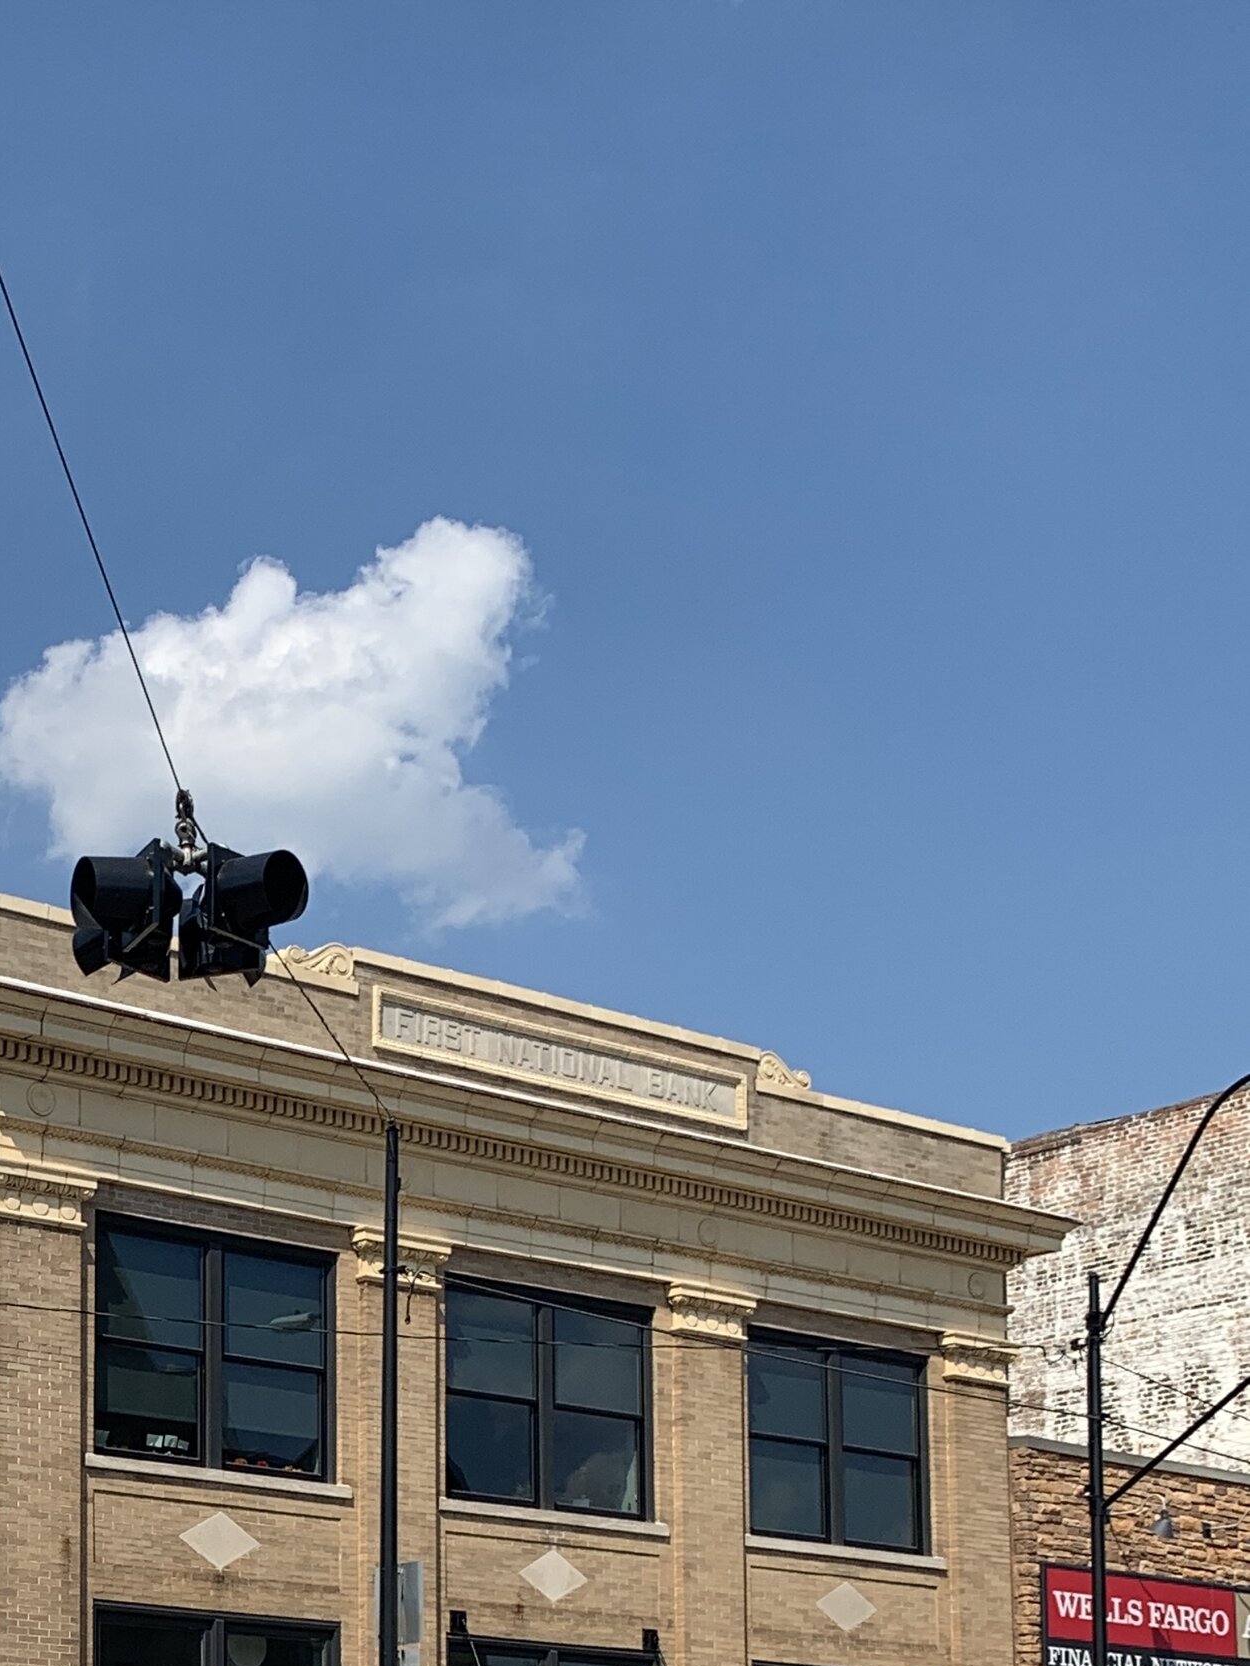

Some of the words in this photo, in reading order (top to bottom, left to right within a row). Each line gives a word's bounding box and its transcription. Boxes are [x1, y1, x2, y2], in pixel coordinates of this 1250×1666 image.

[394, 1007, 481, 1056] FIRST
[496, 1032, 633, 1093] NATIONAL
[648, 1063, 721, 1112] BANK
[1052, 1590, 1144, 1626] WELS
[1147, 1601, 1230, 1637] FARGO
